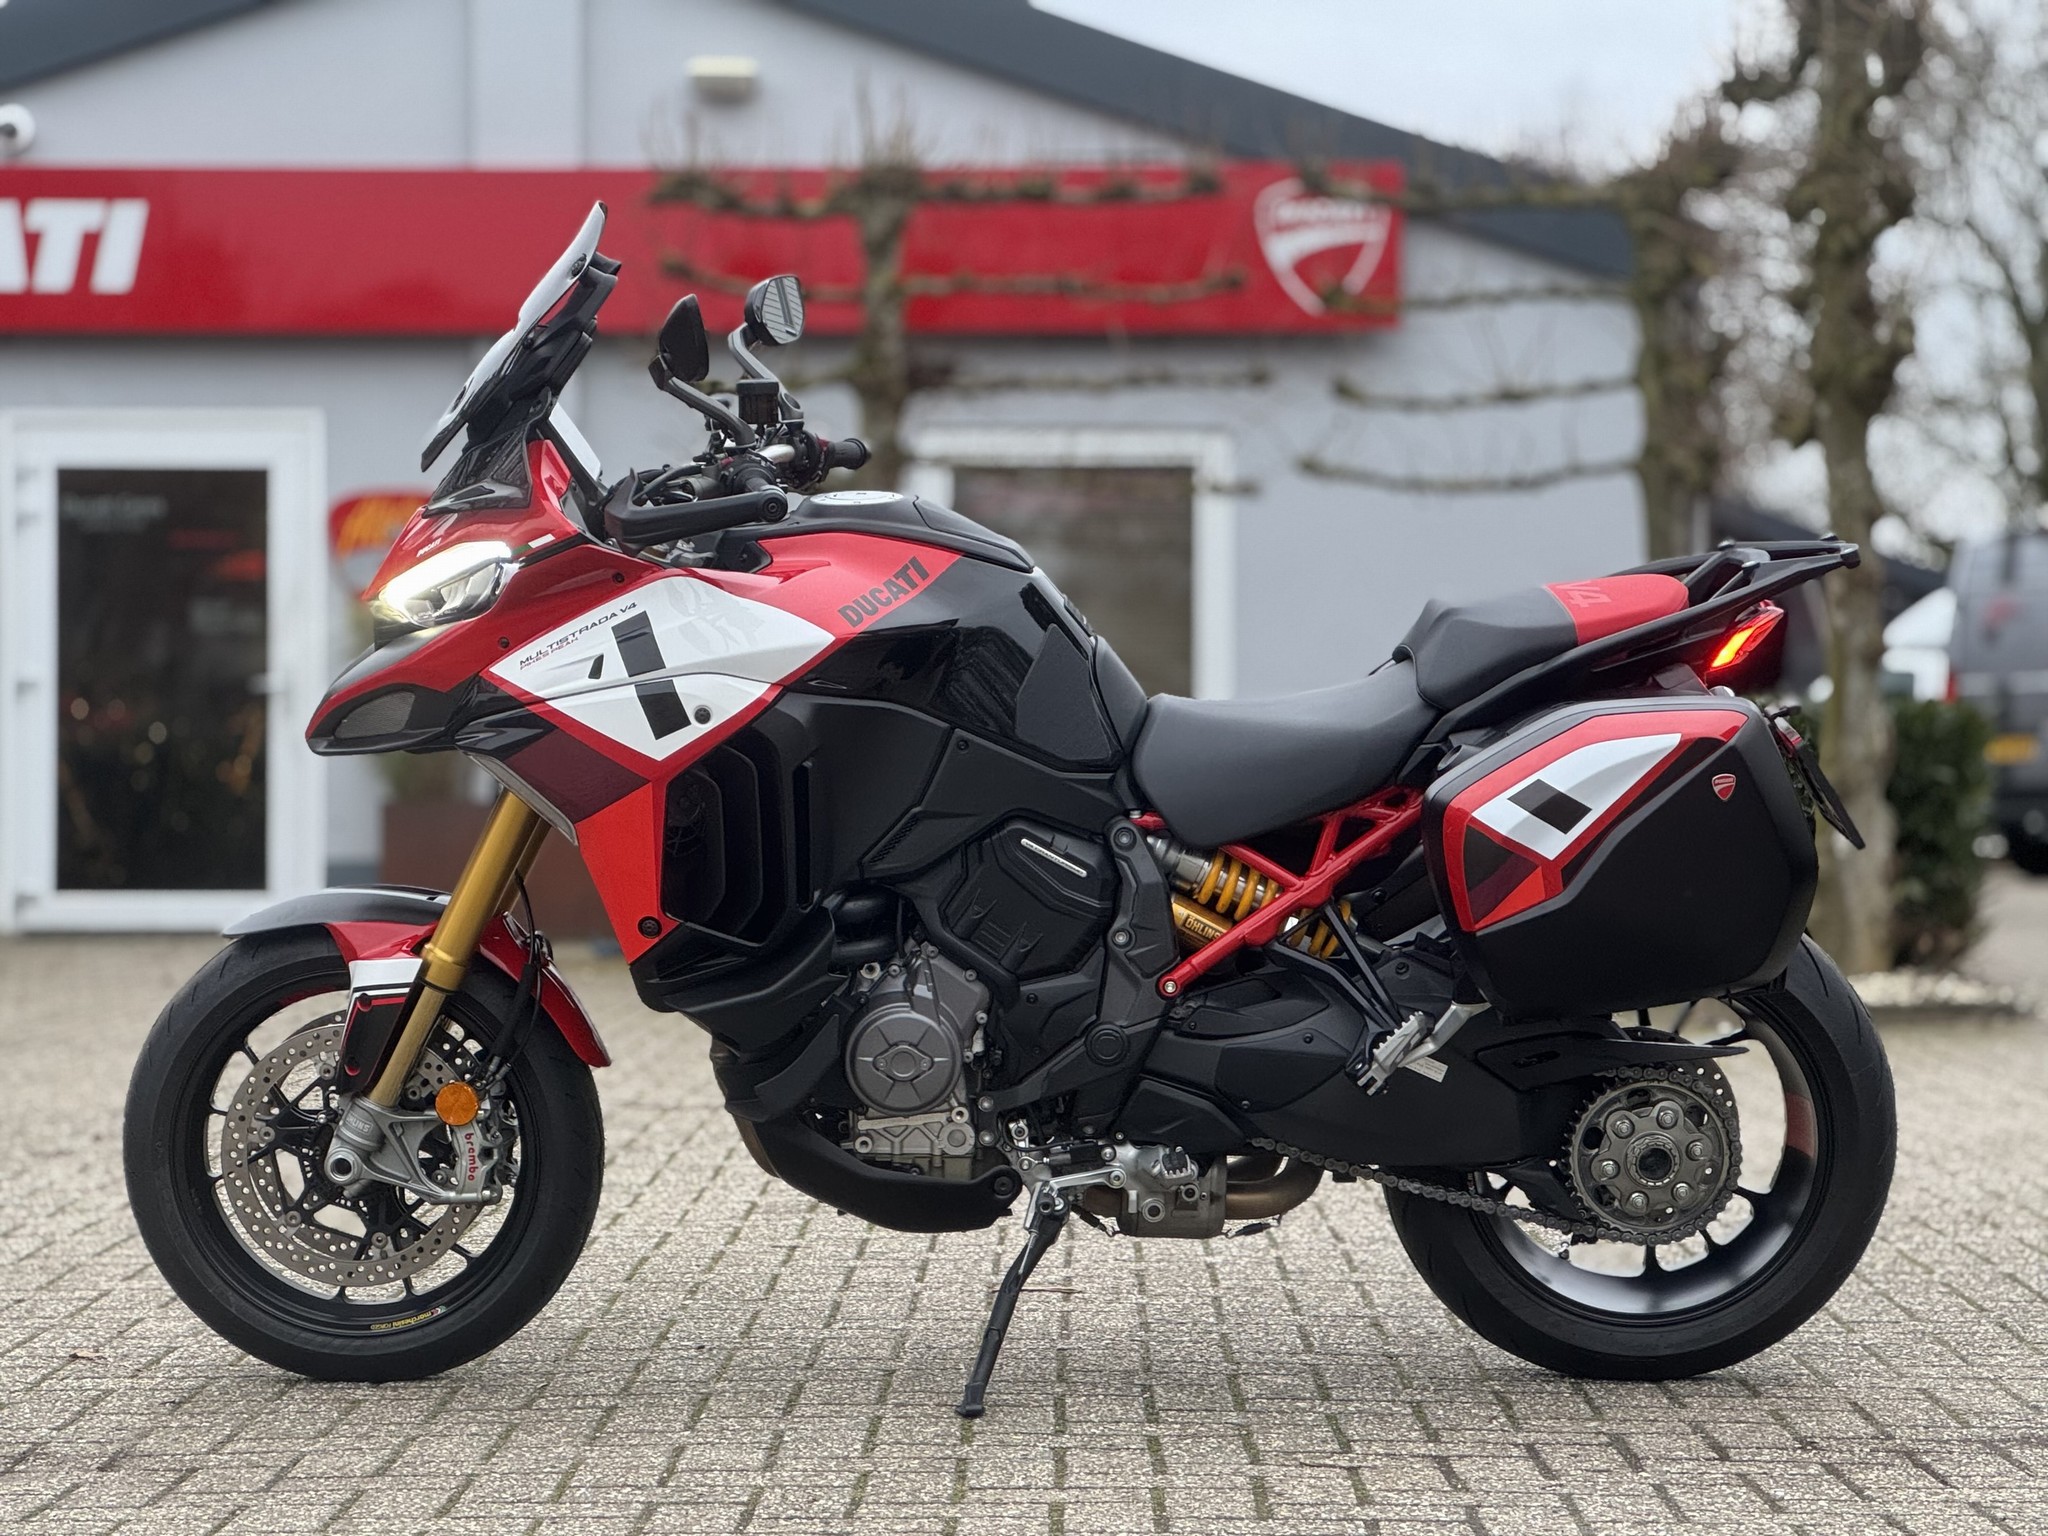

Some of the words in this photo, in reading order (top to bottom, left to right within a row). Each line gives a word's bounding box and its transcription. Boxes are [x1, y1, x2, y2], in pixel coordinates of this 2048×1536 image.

[837, 555, 930, 628] DUCATI
[519, 612, 619, 666] MULTISTRADA
[619, 602, 638, 614] V4
[550, 637, 579, 653] PEAK
[464, 1132, 479, 1181] brembo
[392, 1311, 432, 1328] marchesini
